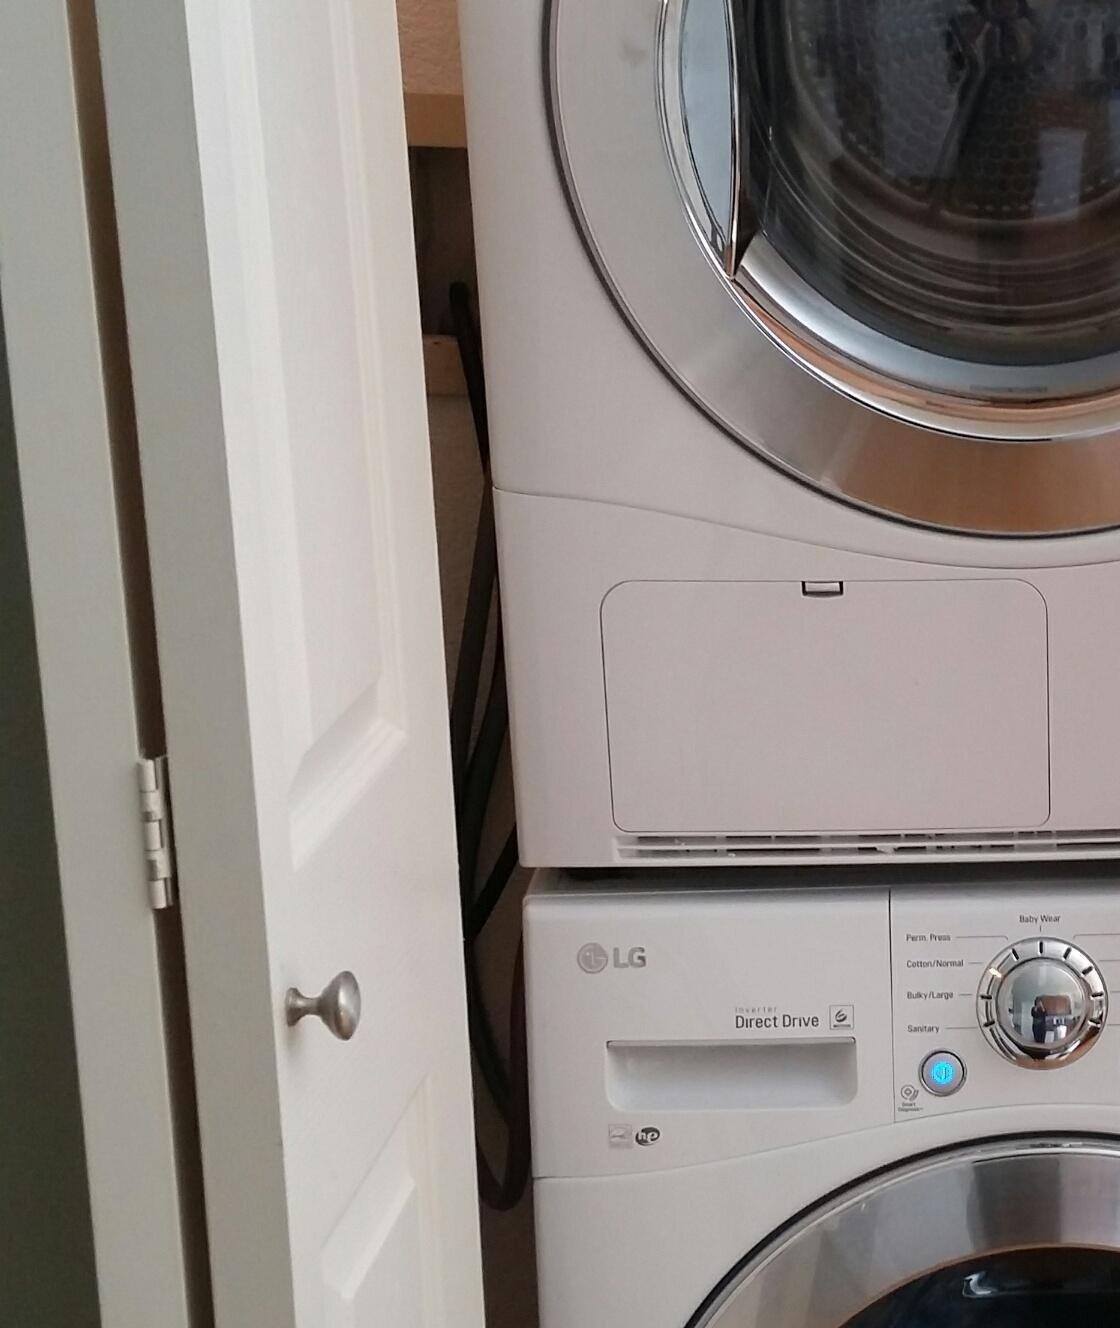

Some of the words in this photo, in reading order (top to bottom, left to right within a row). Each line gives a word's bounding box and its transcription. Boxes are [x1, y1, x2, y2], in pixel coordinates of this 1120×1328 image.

[1019, 915, 1037, 924] Baby
[1040, 914, 1060, 923] Wear
[930, 933, 951, 941] Press
[613, 947, 646, 968] LG
[906, 958, 964, 968] Cotton/Normal
[906, 991, 954, 1000] Bulky/Large
[735, 1014, 779, 1029] Direct
[783, 1013, 819, 1028] Drive
[907, 1024, 940, 1034] Sanitary
